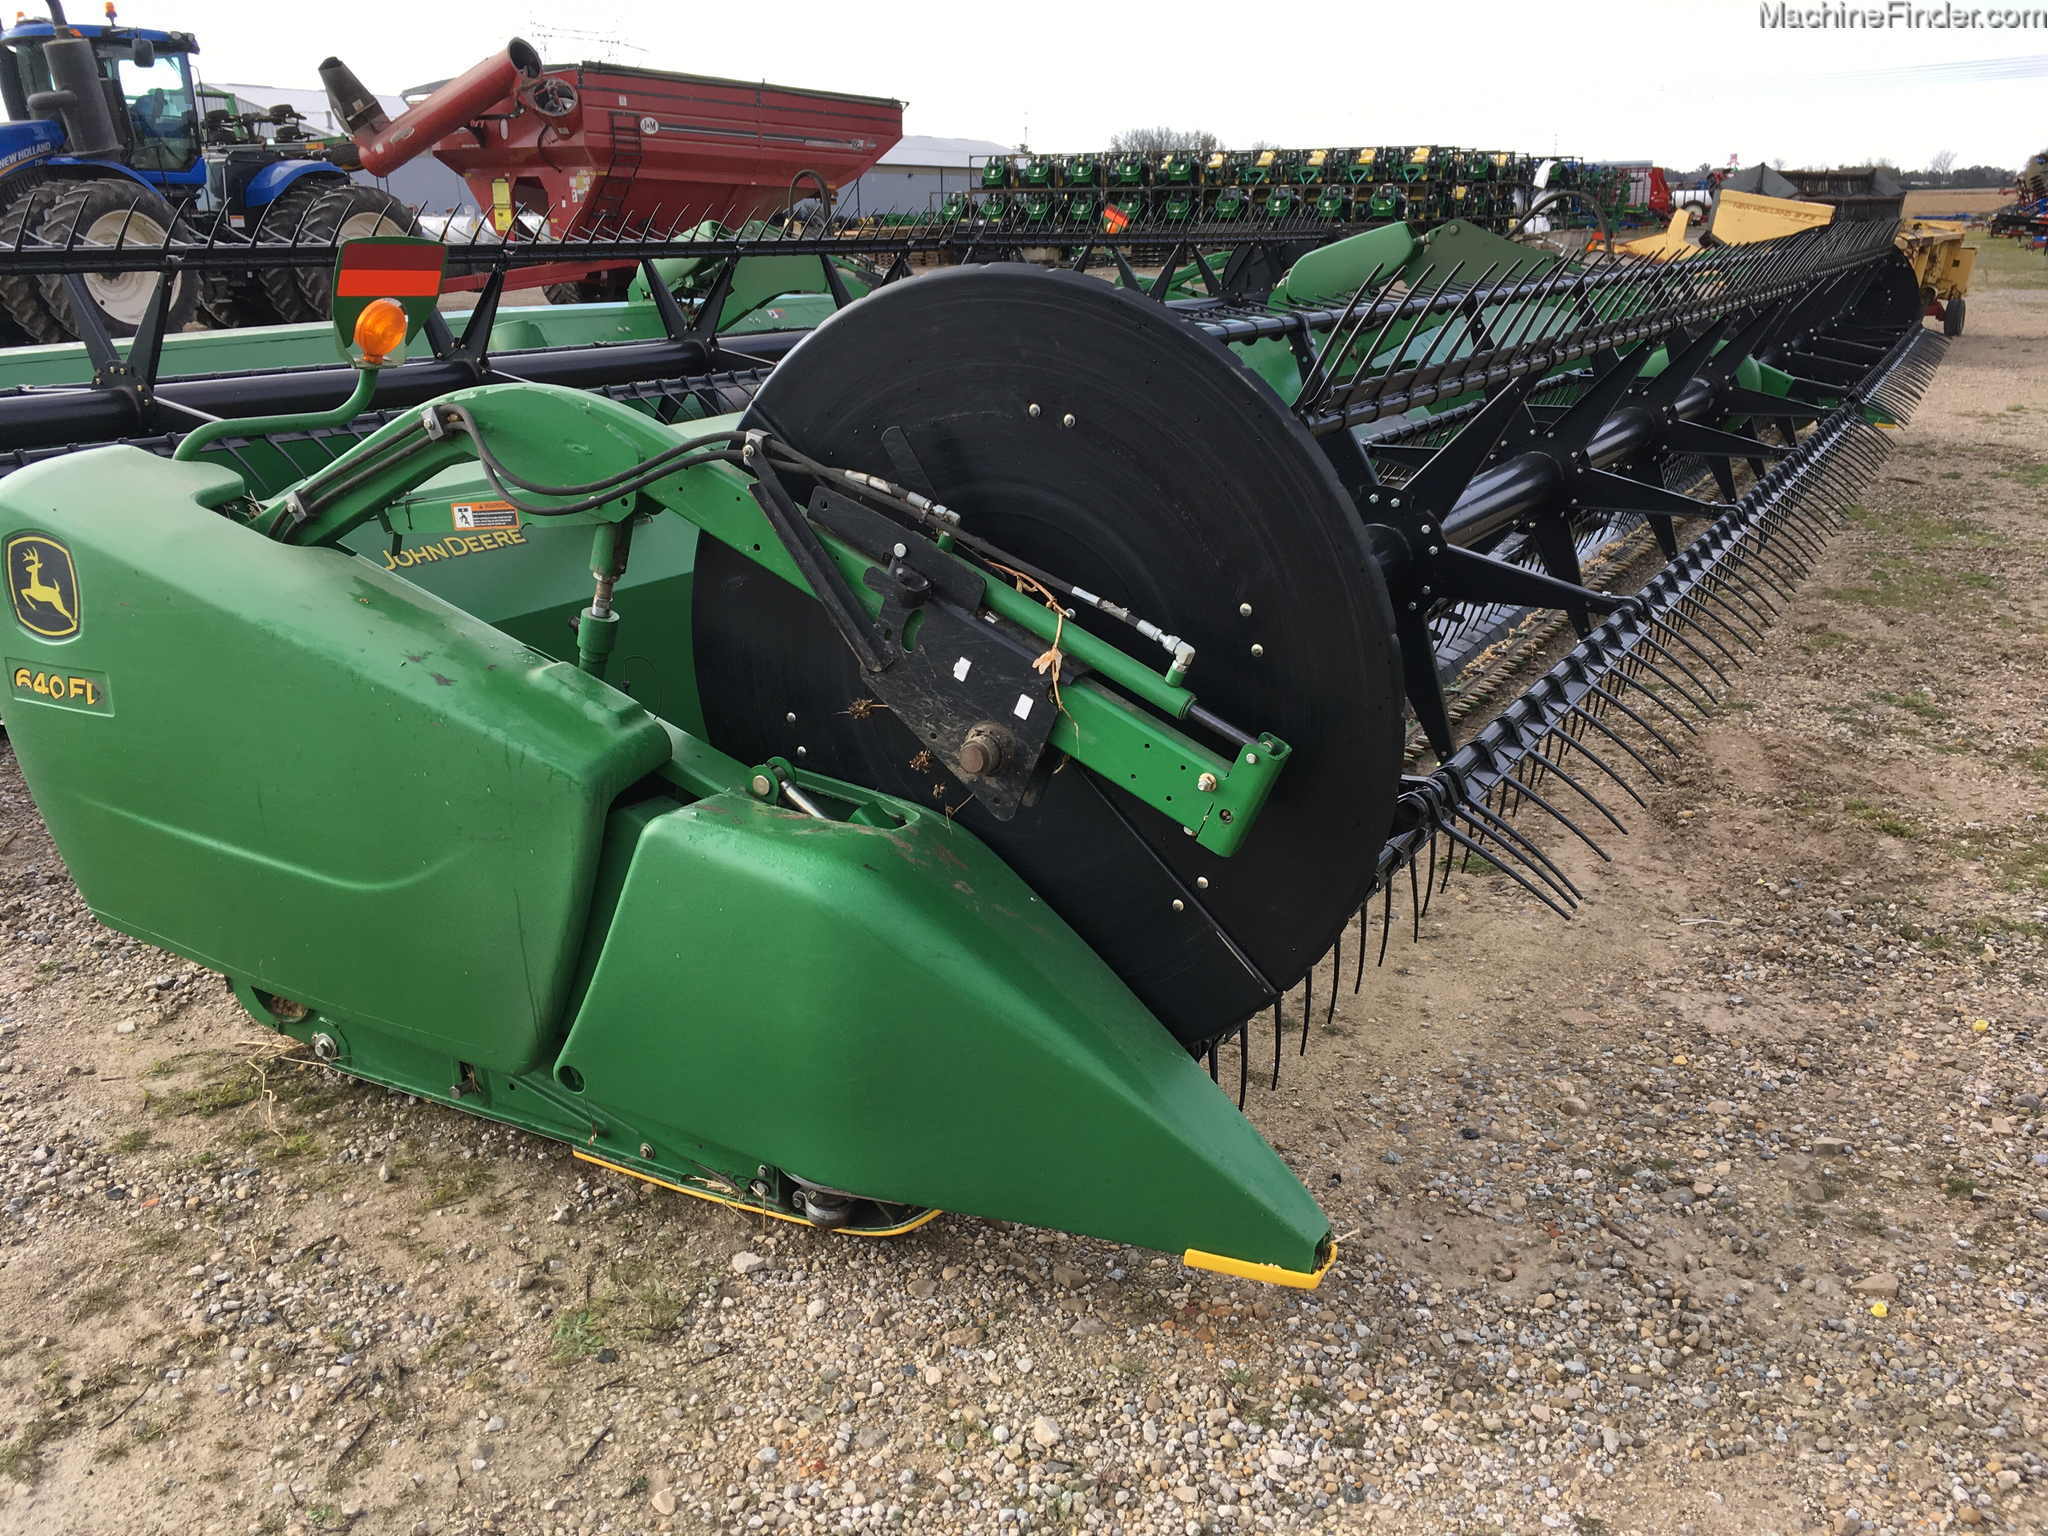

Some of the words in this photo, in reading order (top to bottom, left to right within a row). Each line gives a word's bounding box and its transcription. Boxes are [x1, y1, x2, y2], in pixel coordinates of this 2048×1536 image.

[641, 120, 656, 131] J&M
[0, 153, 17, 169] NEW
[18, 142, 51, 159] HOLLAND
[1753, 206, 1792, 217] HOLLAND
[382, 543, 450, 571] JOHN
[443, 529, 528, 557] DEERE
